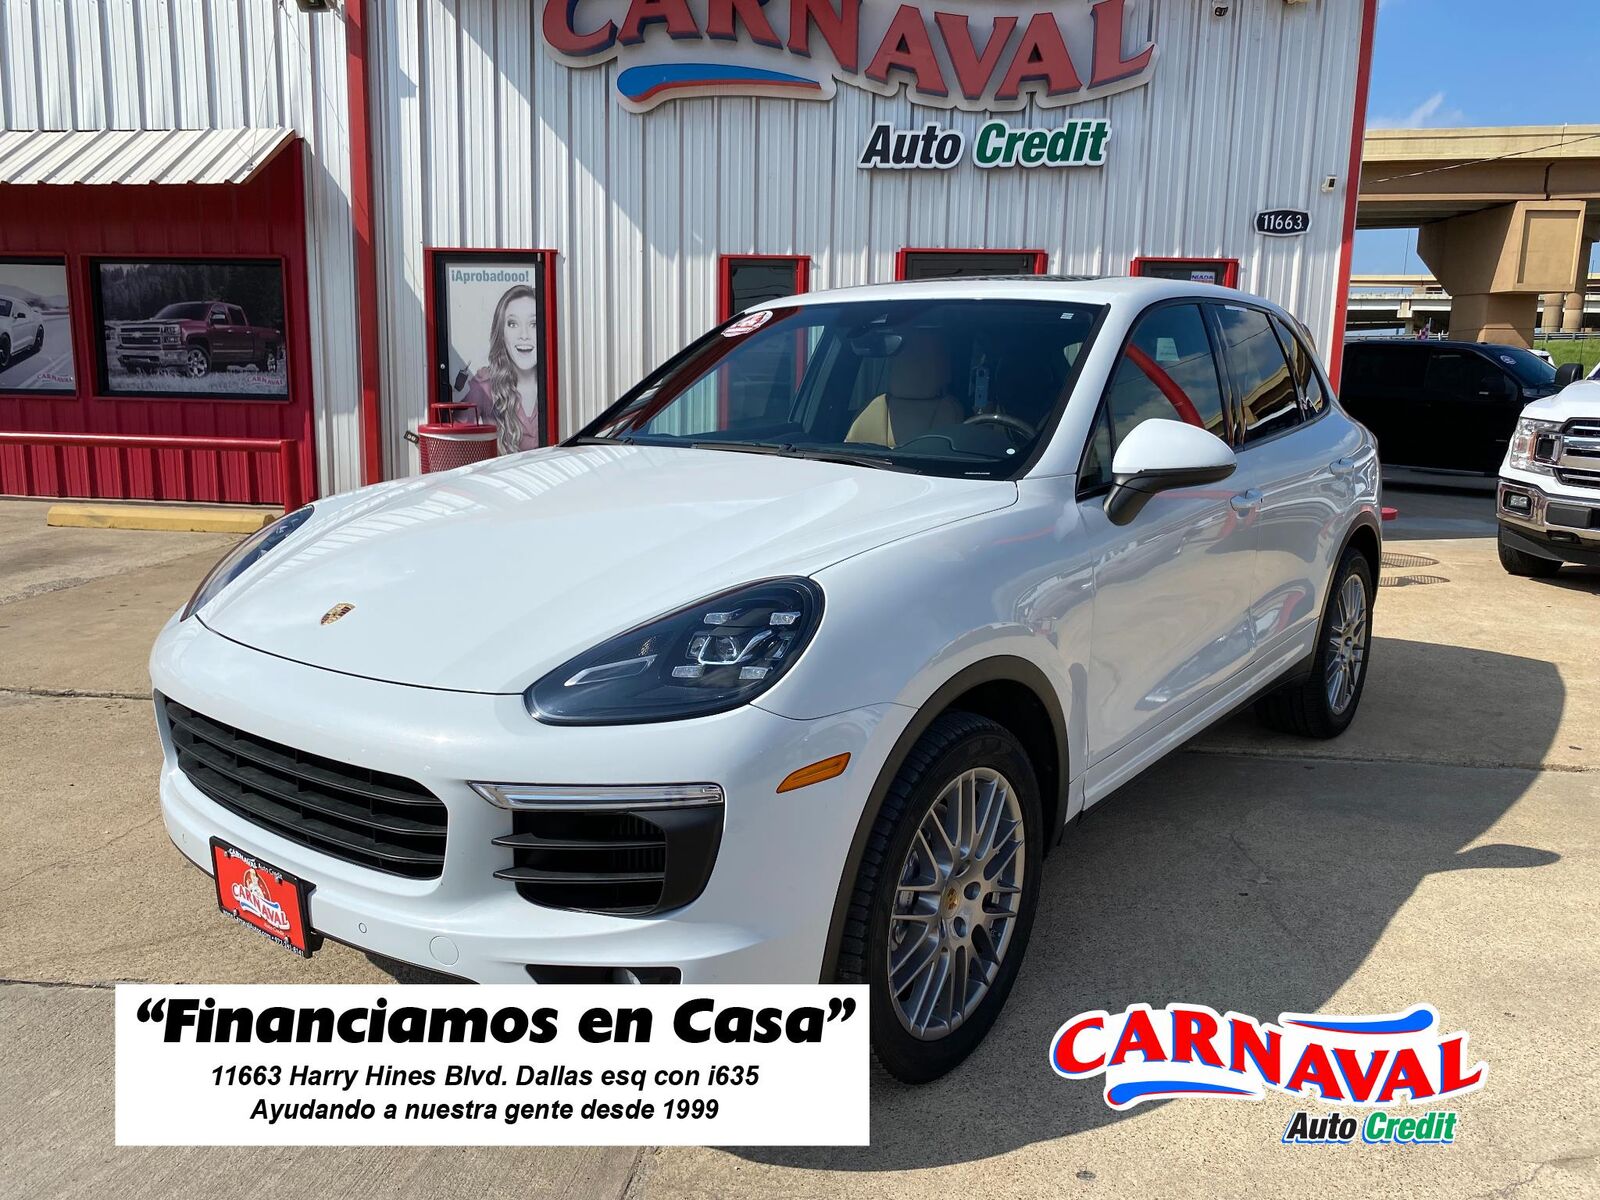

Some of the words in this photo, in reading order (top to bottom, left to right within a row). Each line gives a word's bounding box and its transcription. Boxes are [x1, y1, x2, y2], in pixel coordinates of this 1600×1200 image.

[860, 124, 963, 165] Auto
[975, 120, 1109, 165] Credit
[1262, 214, 1303, 231] 11663
[232, 884, 290, 928] CARNAVAL
